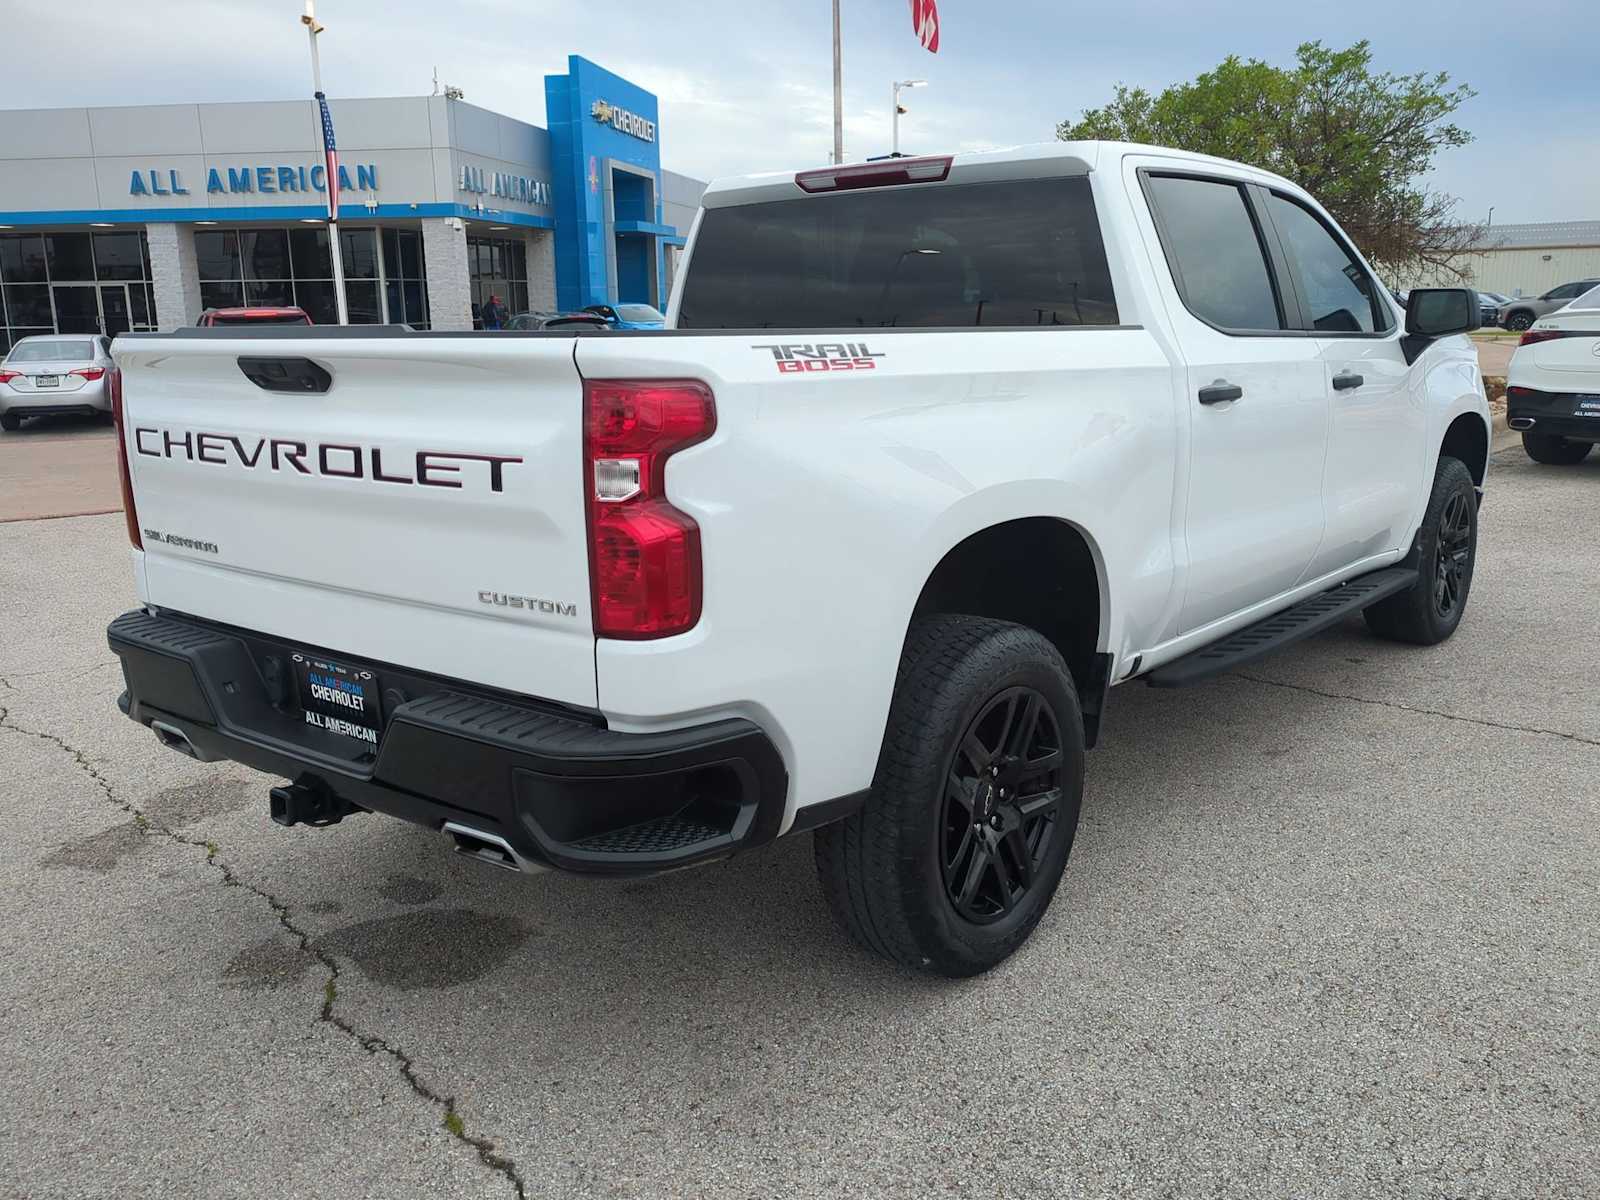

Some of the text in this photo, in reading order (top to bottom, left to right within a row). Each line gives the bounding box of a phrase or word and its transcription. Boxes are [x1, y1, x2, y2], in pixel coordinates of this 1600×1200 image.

[612, 105, 656, 143] CHEVROLET
[130, 164, 377, 195] ALL AMERICAN
[459, 165, 551, 207] ALL AMERICAN
[751, 343, 886, 360] TRAIL
[776, 358, 876, 373] BOSS
[136, 427, 524, 493] CHEVROLET
[143, 528, 219, 555] SILVERADO
[478, 590, 577, 617] CUSTOM
[309, 672, 363, 695] ALL AMERICAN
[311, 683, 364, 711] CHEVROLET
[305, 711, 324, 727] ALL
[325, 716, 377, 743] AMERICAN
